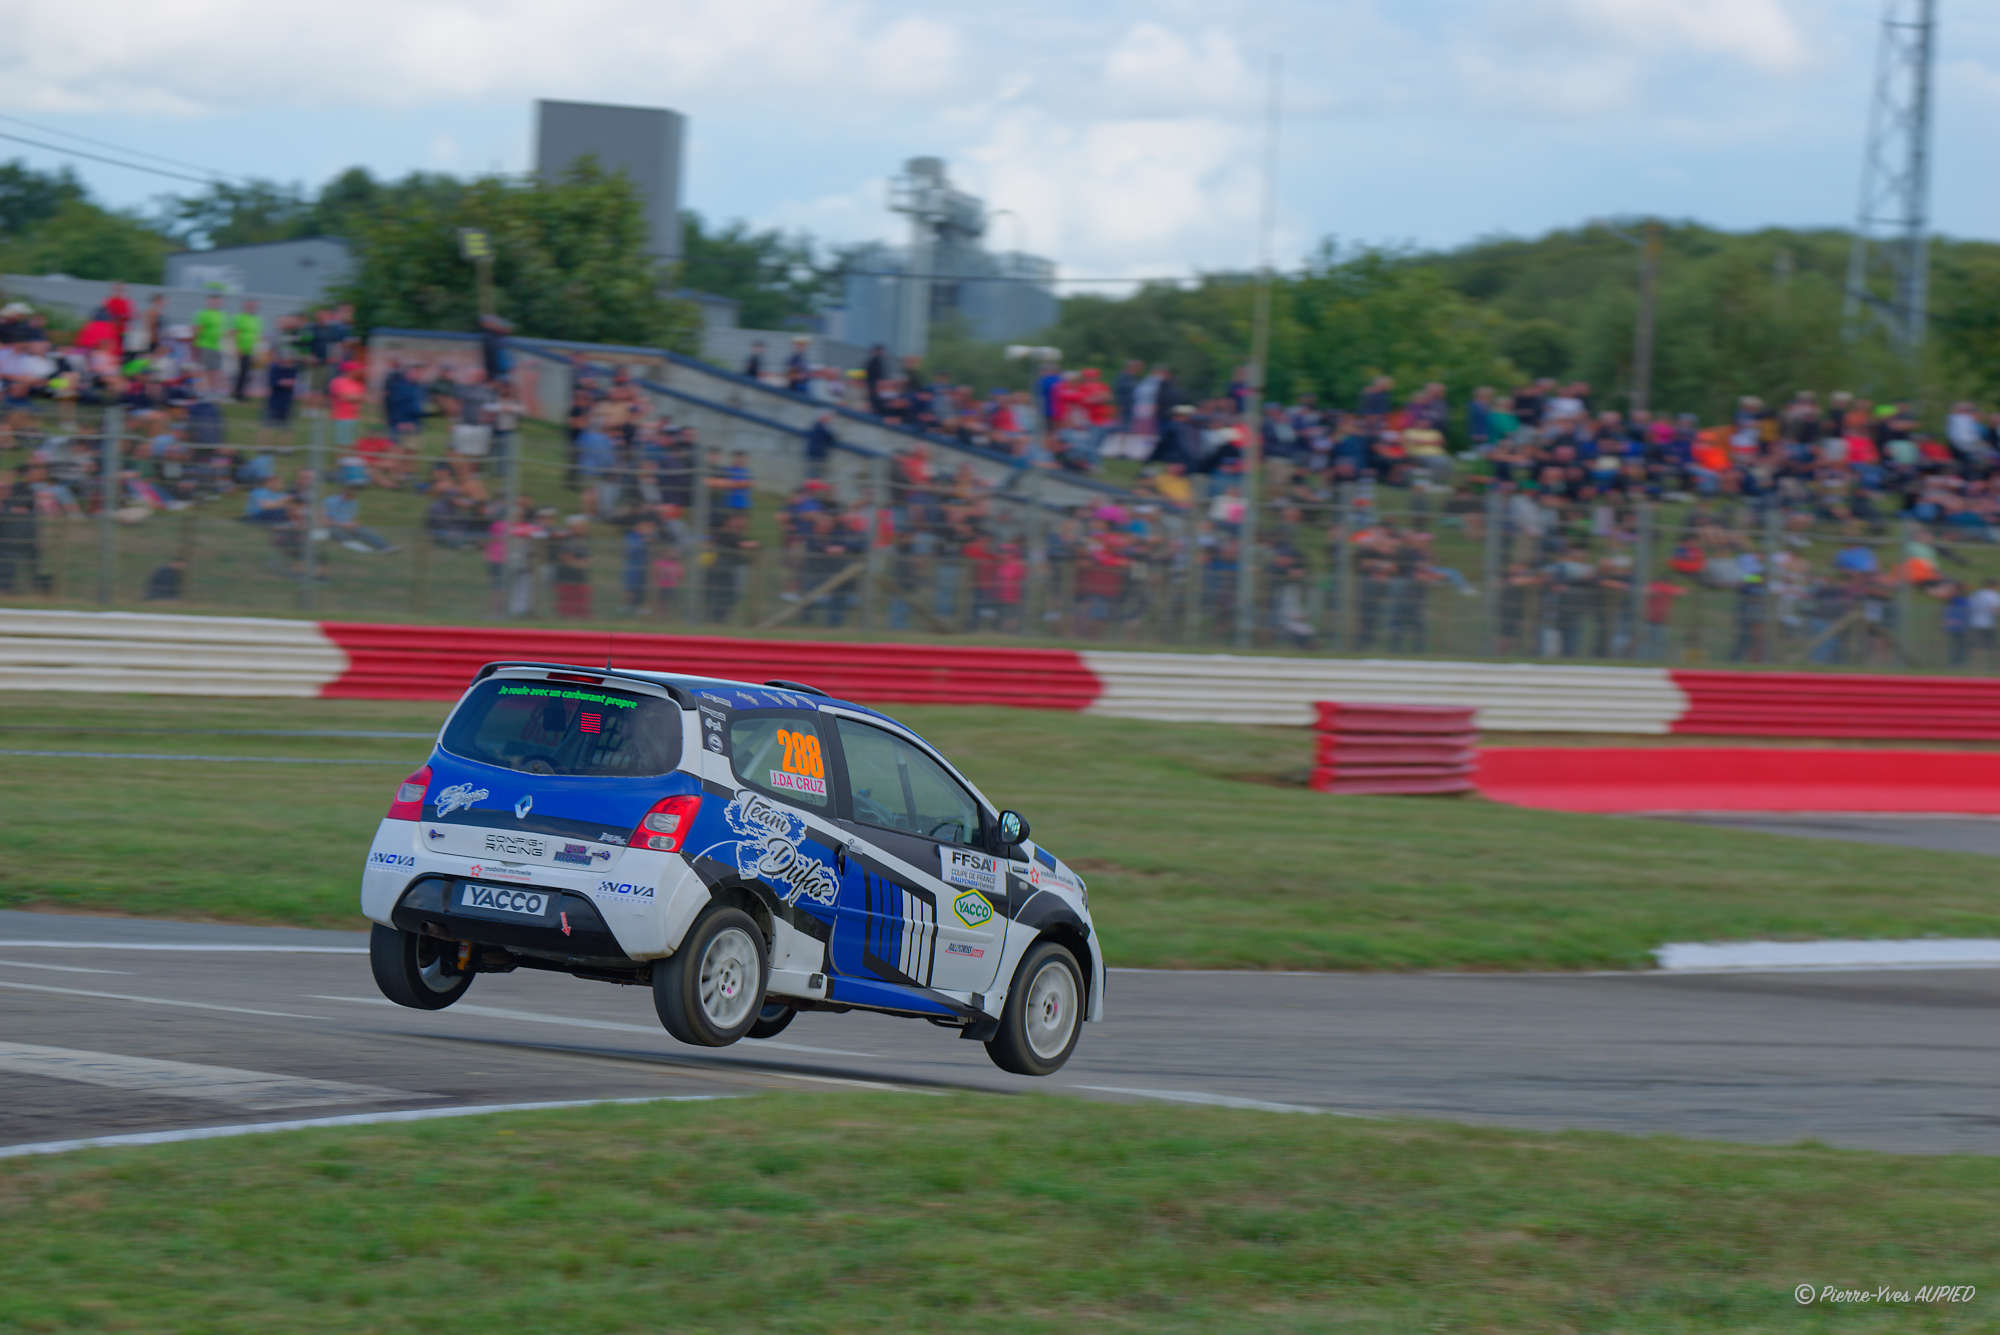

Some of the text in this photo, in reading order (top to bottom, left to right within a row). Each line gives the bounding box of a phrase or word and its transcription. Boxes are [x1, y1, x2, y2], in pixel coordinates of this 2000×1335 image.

[508, 686, 529, 696] roule
[530, 688, 549, 697] avec
[549, 689, 561, 698] un
[562, 689, 606, 703] carburant
[604, 697, 638, 709] propre
[776, 728, 824, 779] 288
[796, 776, 825, 793] CRUZ
[736, 789, 788, 833] Team
[375, 852, 415, 867] NOVA
[485, 843, 543, 857] RACING
[952, 850, 992, 872] FFSA
[471, 886, 542, 913] YACCO
[605, 881, 655, 898] NOVA
[959, 900, 989, 918] YACCO
